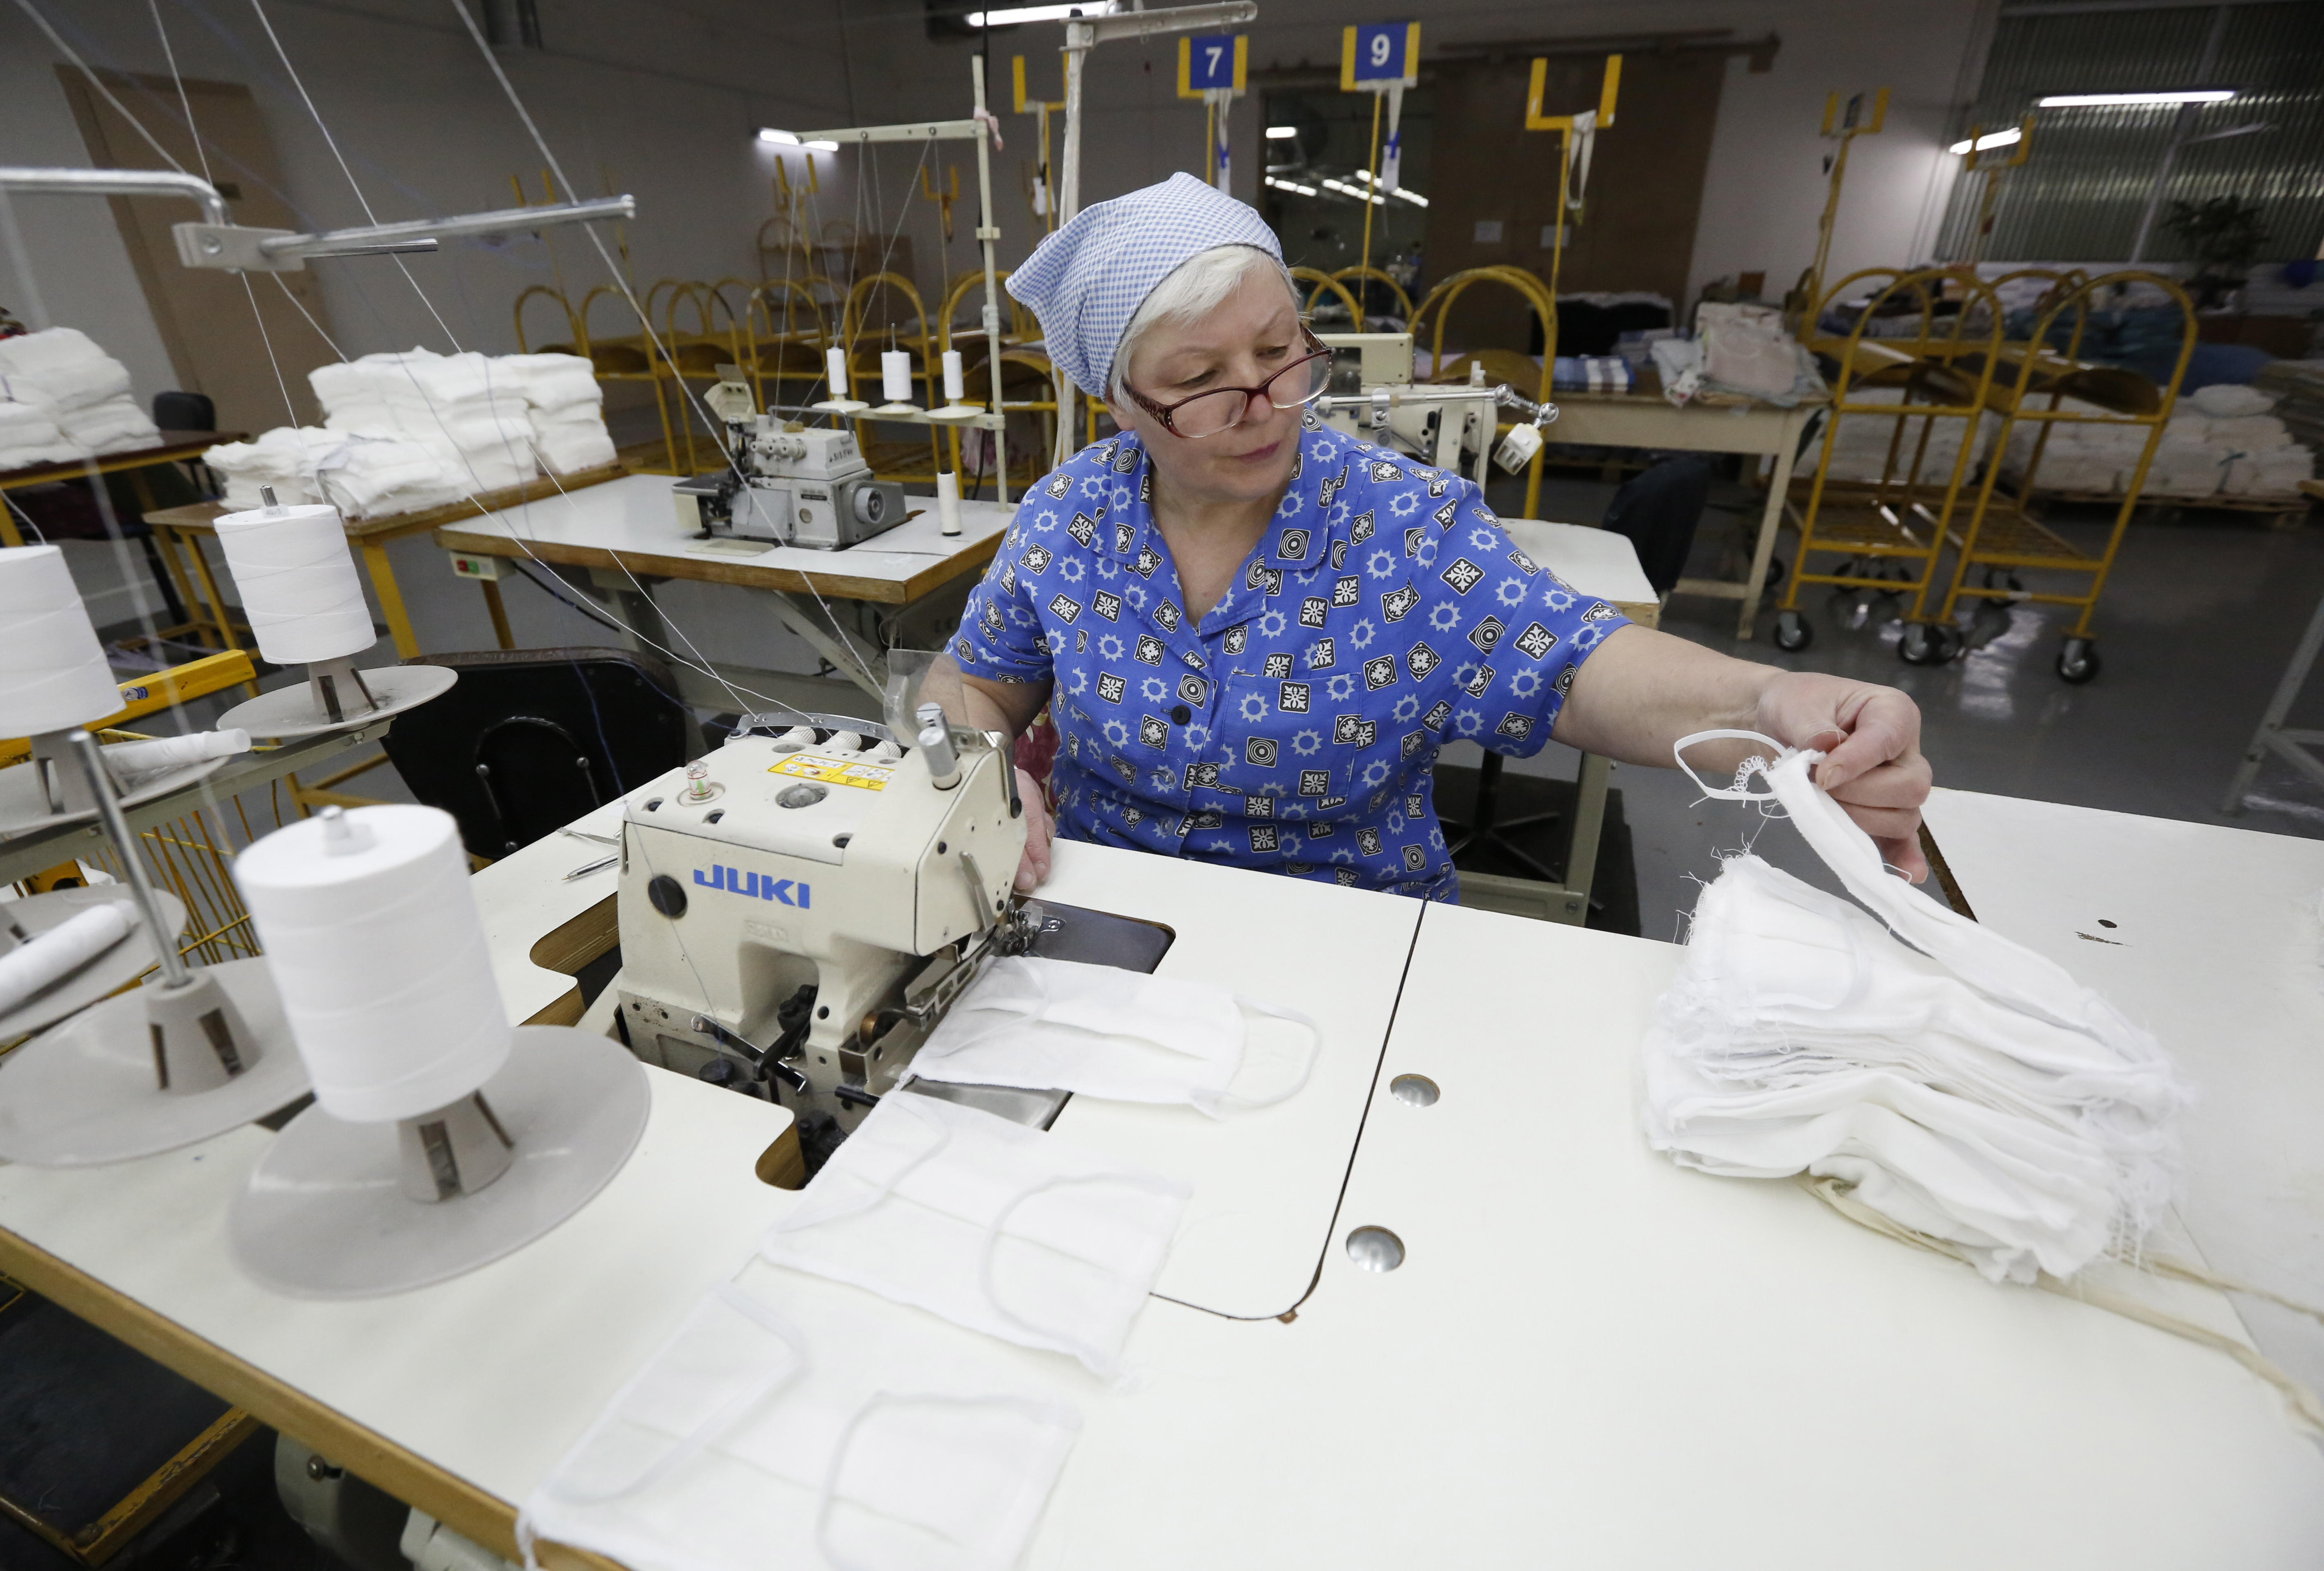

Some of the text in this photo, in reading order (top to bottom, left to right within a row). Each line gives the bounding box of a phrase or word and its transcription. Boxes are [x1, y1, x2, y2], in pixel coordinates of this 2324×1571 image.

[1205, 46, 1223, 78] 7
[1371, 34, 1391, 67] 9
[694, 864, 810, 909] JUKI
